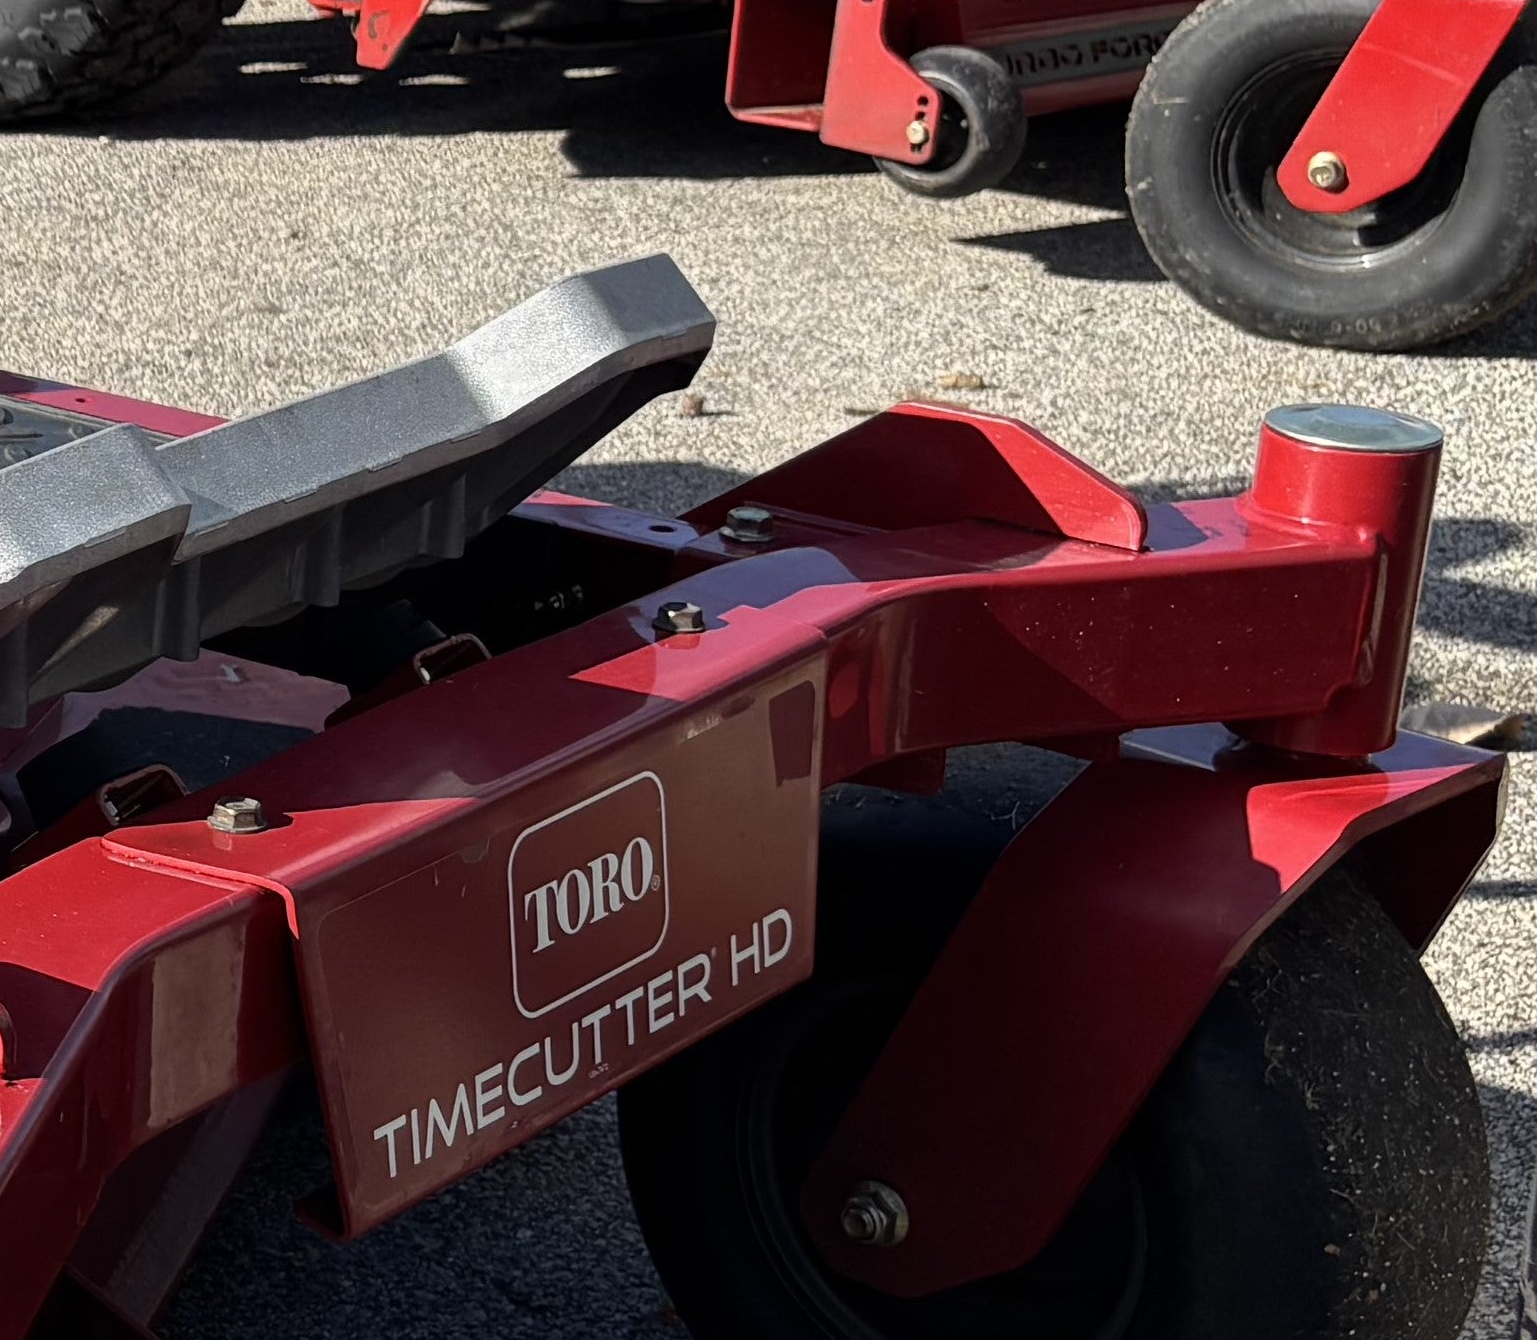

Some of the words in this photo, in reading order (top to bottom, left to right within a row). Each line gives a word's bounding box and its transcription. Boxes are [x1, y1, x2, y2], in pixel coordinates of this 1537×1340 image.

[523, 836, 654, 954] TORO
[373, 953, 712, 1178] TIMECUTTER
[730, 908, 793, 987] HD
